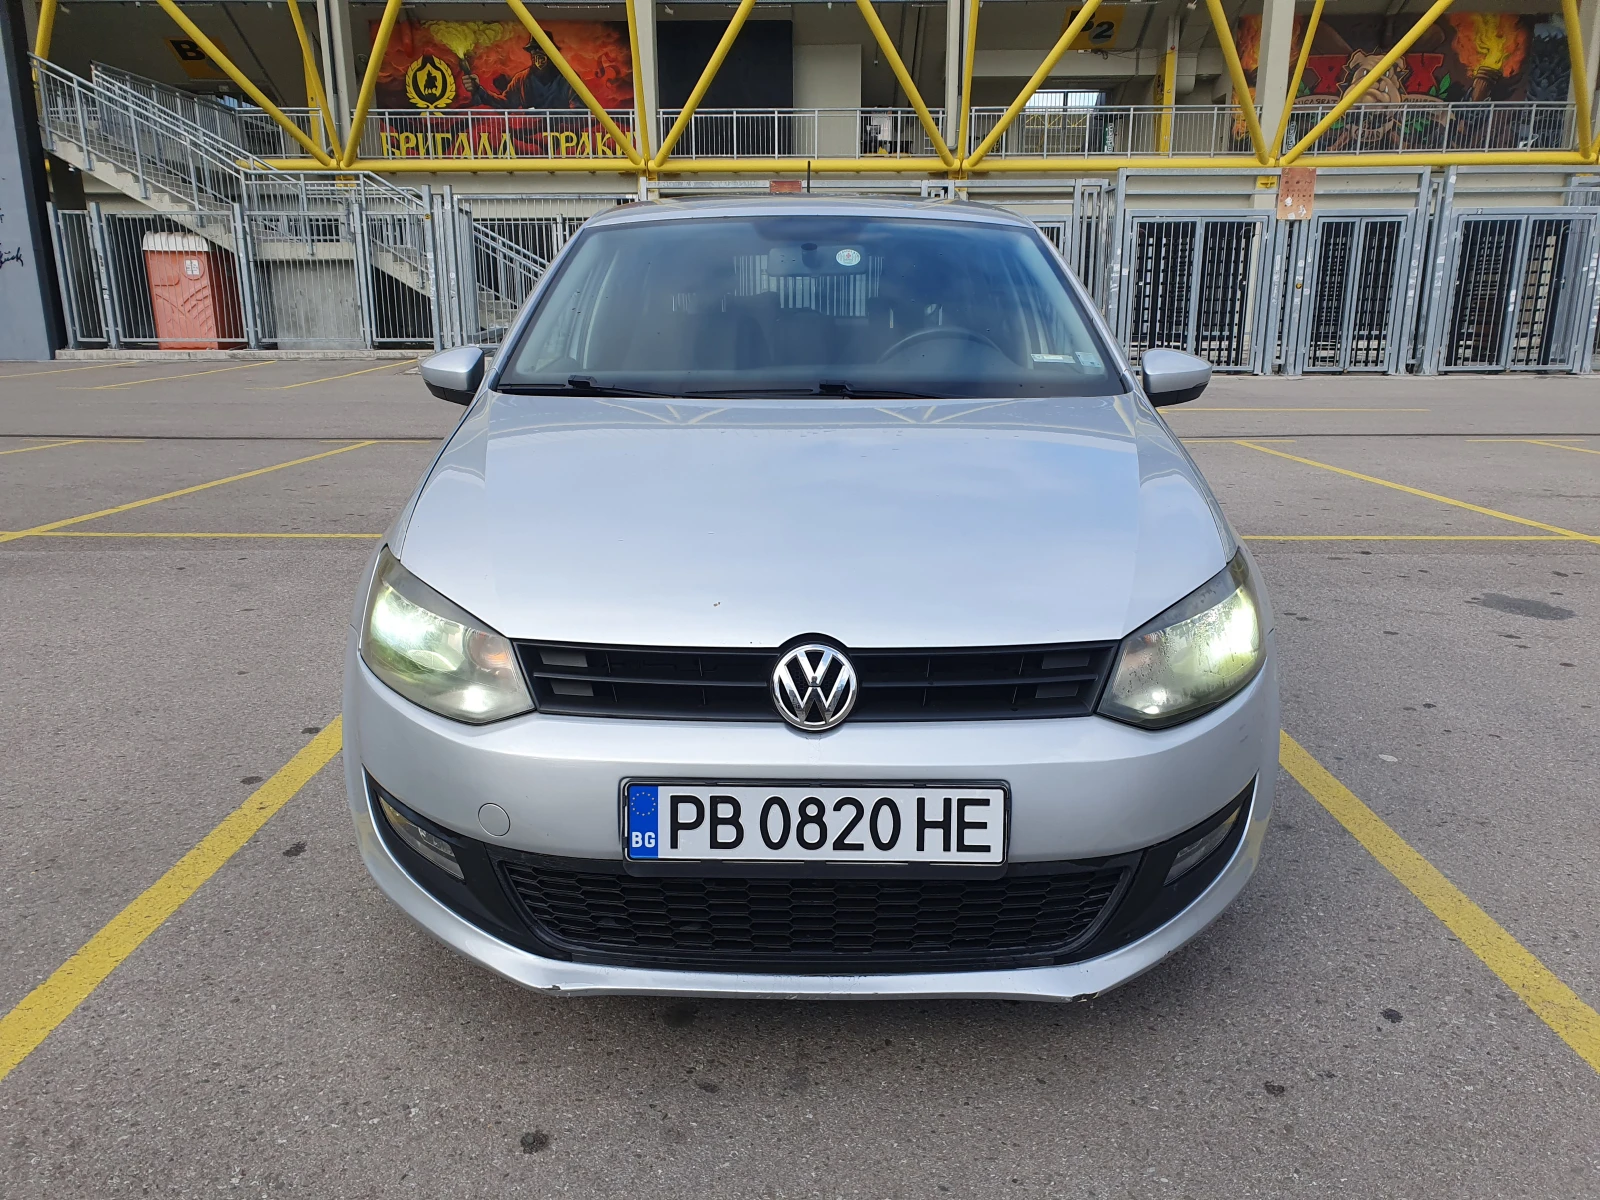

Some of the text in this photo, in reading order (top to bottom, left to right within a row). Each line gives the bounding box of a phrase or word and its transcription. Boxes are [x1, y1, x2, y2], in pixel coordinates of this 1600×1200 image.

[631, 831, 656, 848] BG
[669, 794, 991, 852] PB 0820 HE
